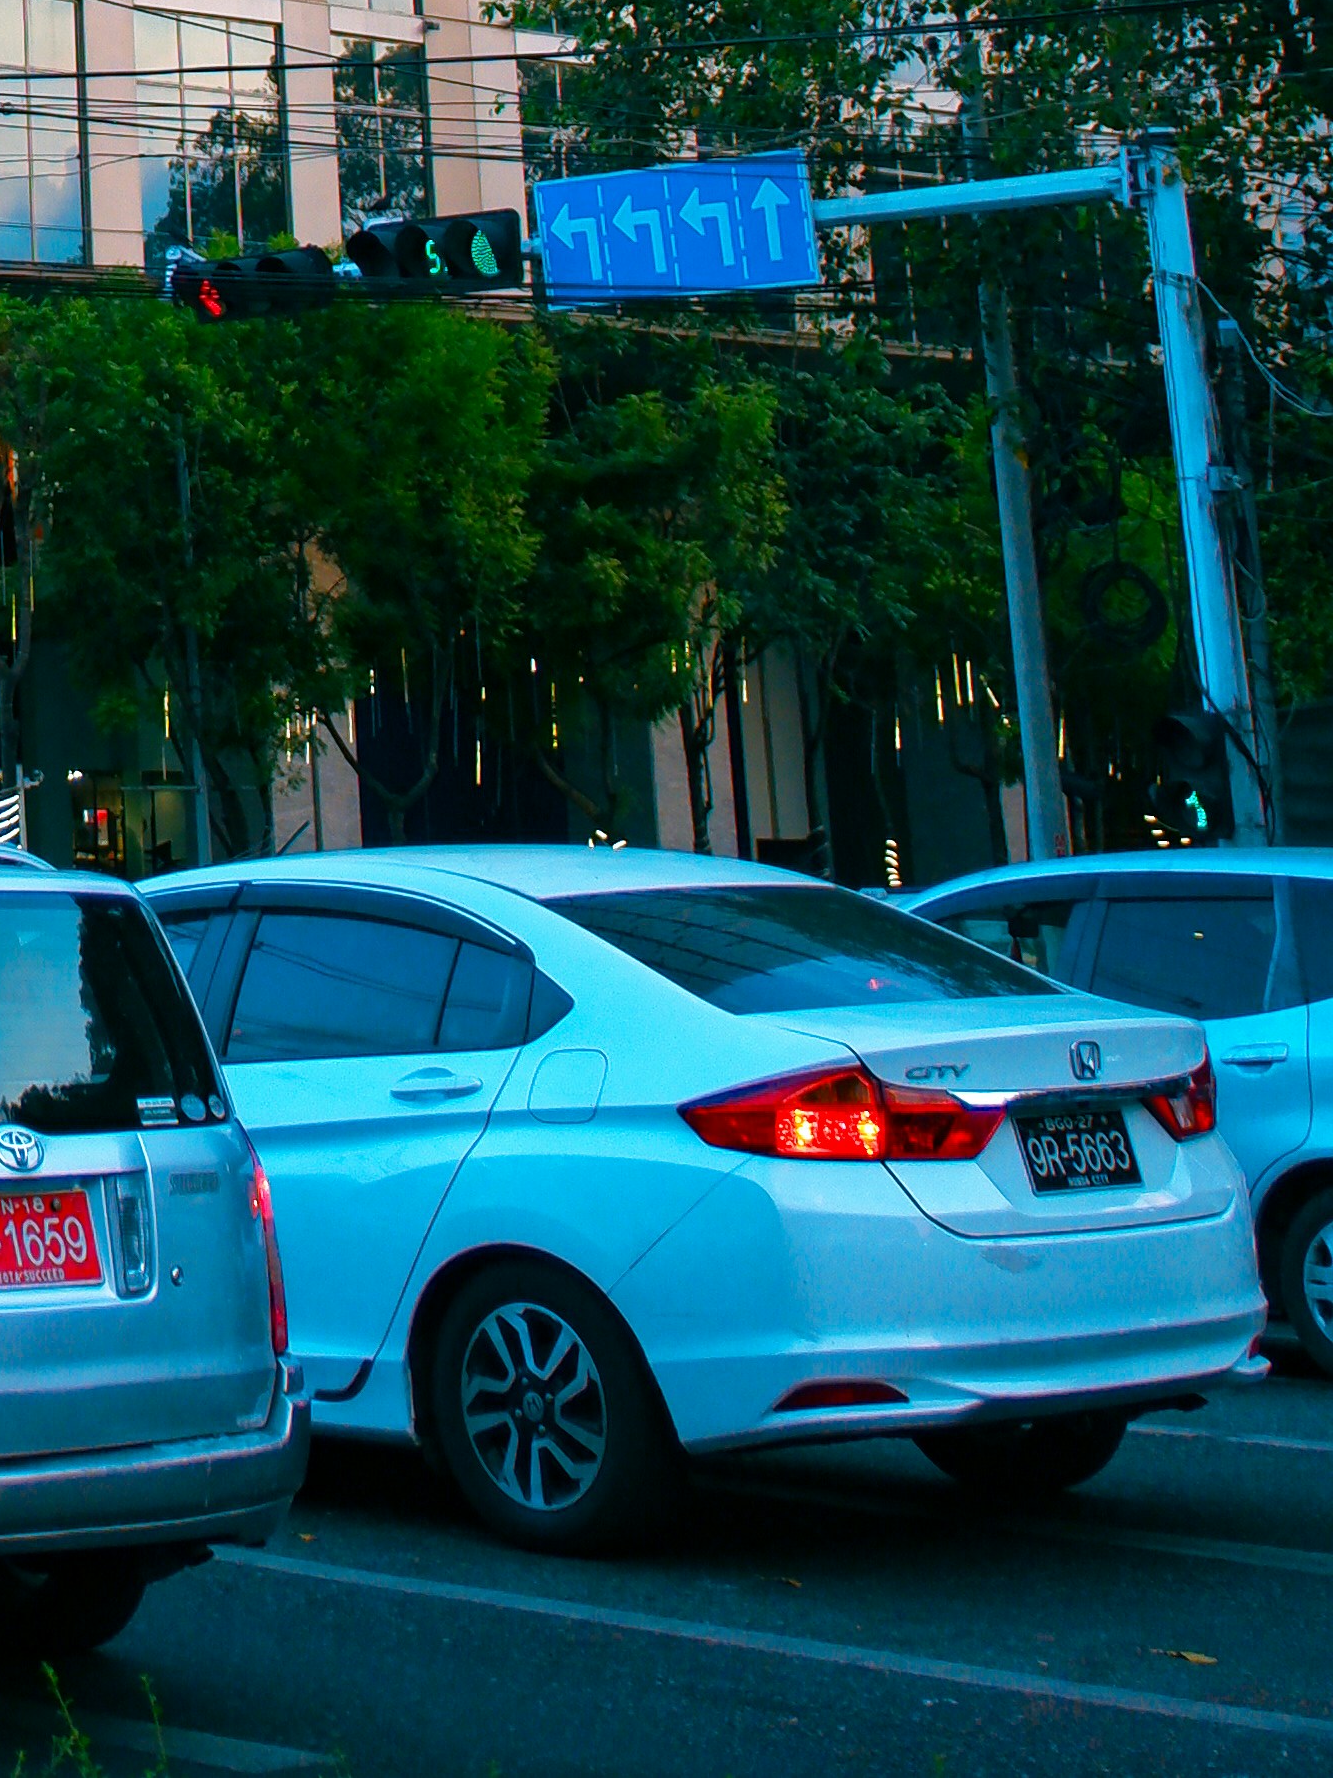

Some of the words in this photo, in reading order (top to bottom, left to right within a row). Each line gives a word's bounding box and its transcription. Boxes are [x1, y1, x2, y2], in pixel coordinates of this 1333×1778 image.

[905, 1063, 972, 1080] CITY
[1027, 1130, 1131, 1178] 9R-5663
[23, 1267, 65, 1282] SUCCEED
